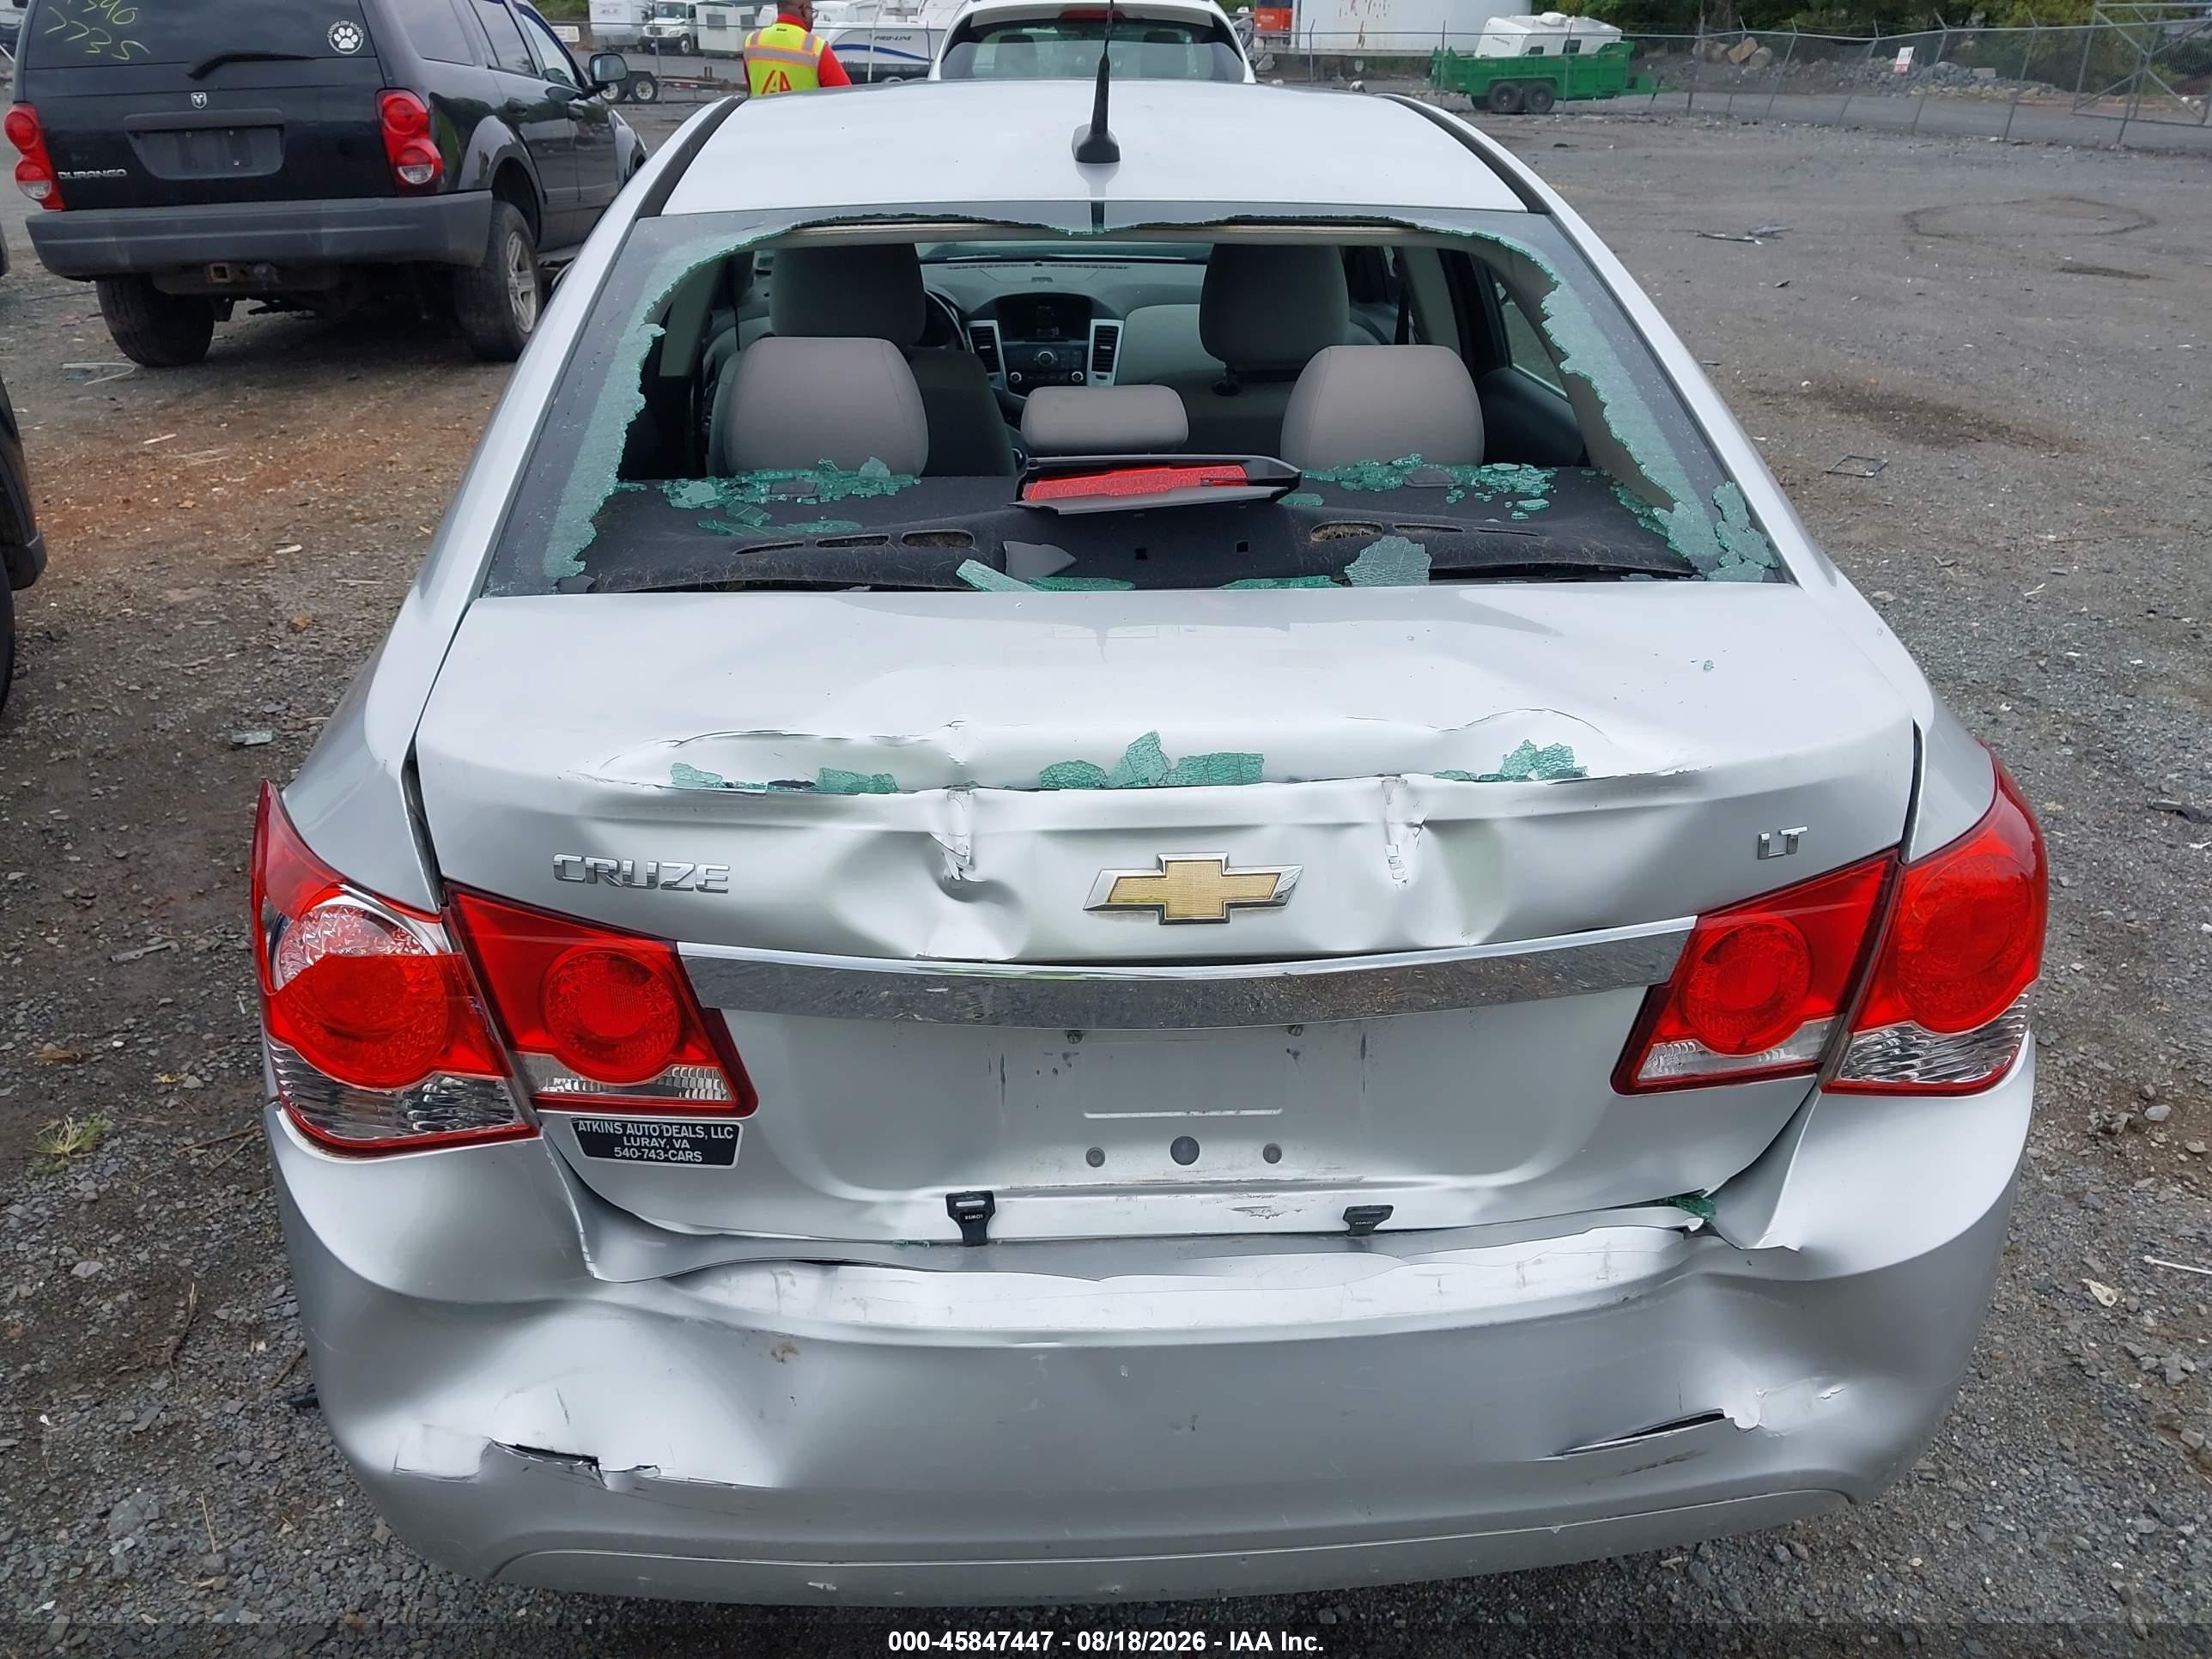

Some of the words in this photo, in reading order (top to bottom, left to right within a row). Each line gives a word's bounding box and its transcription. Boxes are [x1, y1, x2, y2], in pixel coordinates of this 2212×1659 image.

[58, 168, 128, 179] DURANGO
[1757, 825, 1808, 860] LT
[552, 852, 731, 895] CRUZE
[578, 1120, 623, 1134] ATKINS
[626, 1123, 660, 1136] AUTO
[663, 1125, 708, 1140] DEALS,
[711, 1127, 734, 1139] LLC
[623, 1136, 670, 1150] LURAY,
[672, 1139, 690, 1149] VA
[613, 1146, 703, 1163] 540-743-CARS
